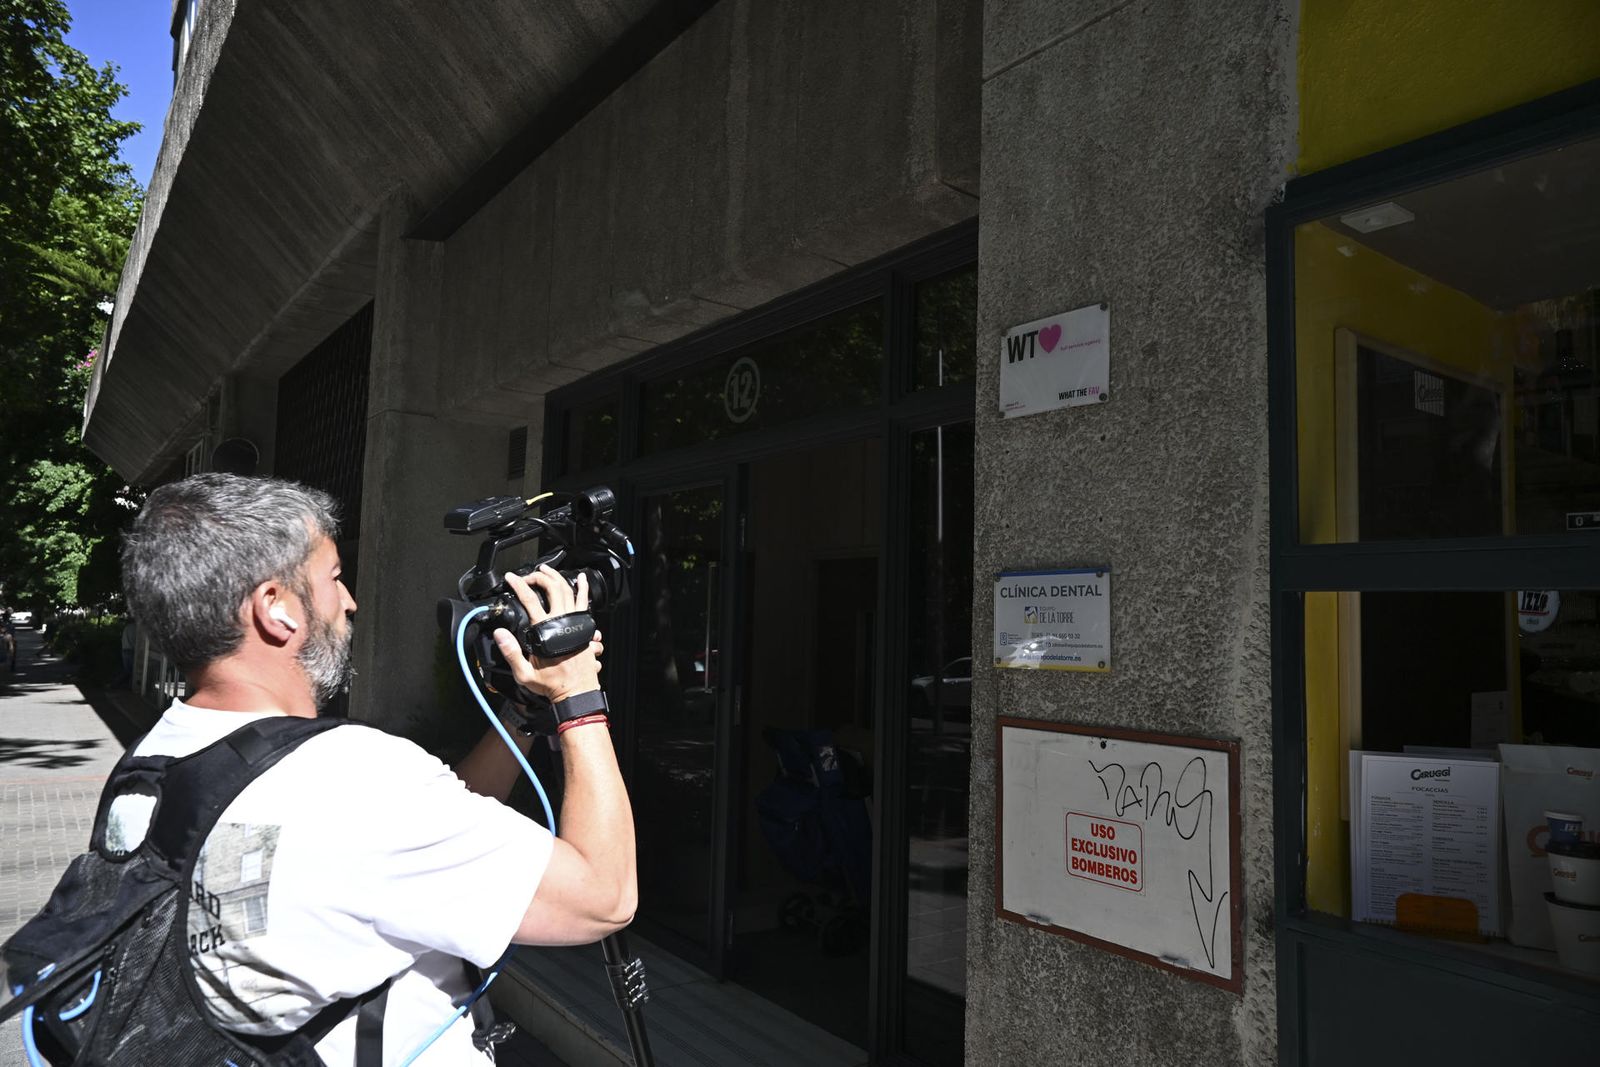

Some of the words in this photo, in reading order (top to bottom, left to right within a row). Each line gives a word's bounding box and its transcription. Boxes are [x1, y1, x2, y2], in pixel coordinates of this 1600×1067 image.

[730, 370, 753, 410] 12
[1058, 390, 1075, 400] WHAT
[1076, 388, 1087, 398] THE
[1088, 386, 1100, 395] FAV
[1000, 584, 1047, 598] CLÍNICA
[1051, 584, 1103, 597] DENTAL
[1039, 612, 1047, 624] DE
[1047, 612, 1056, 624] LA
[1056, 612, 1075, 624] TORRE
[557, 623, 584, 636] SONY
[1090, 823, 1116, 841] USO
[1071, 838, 1138, 865] EXCLUSIVO
[1071, 856, 1138, 885] BOMBEROS
